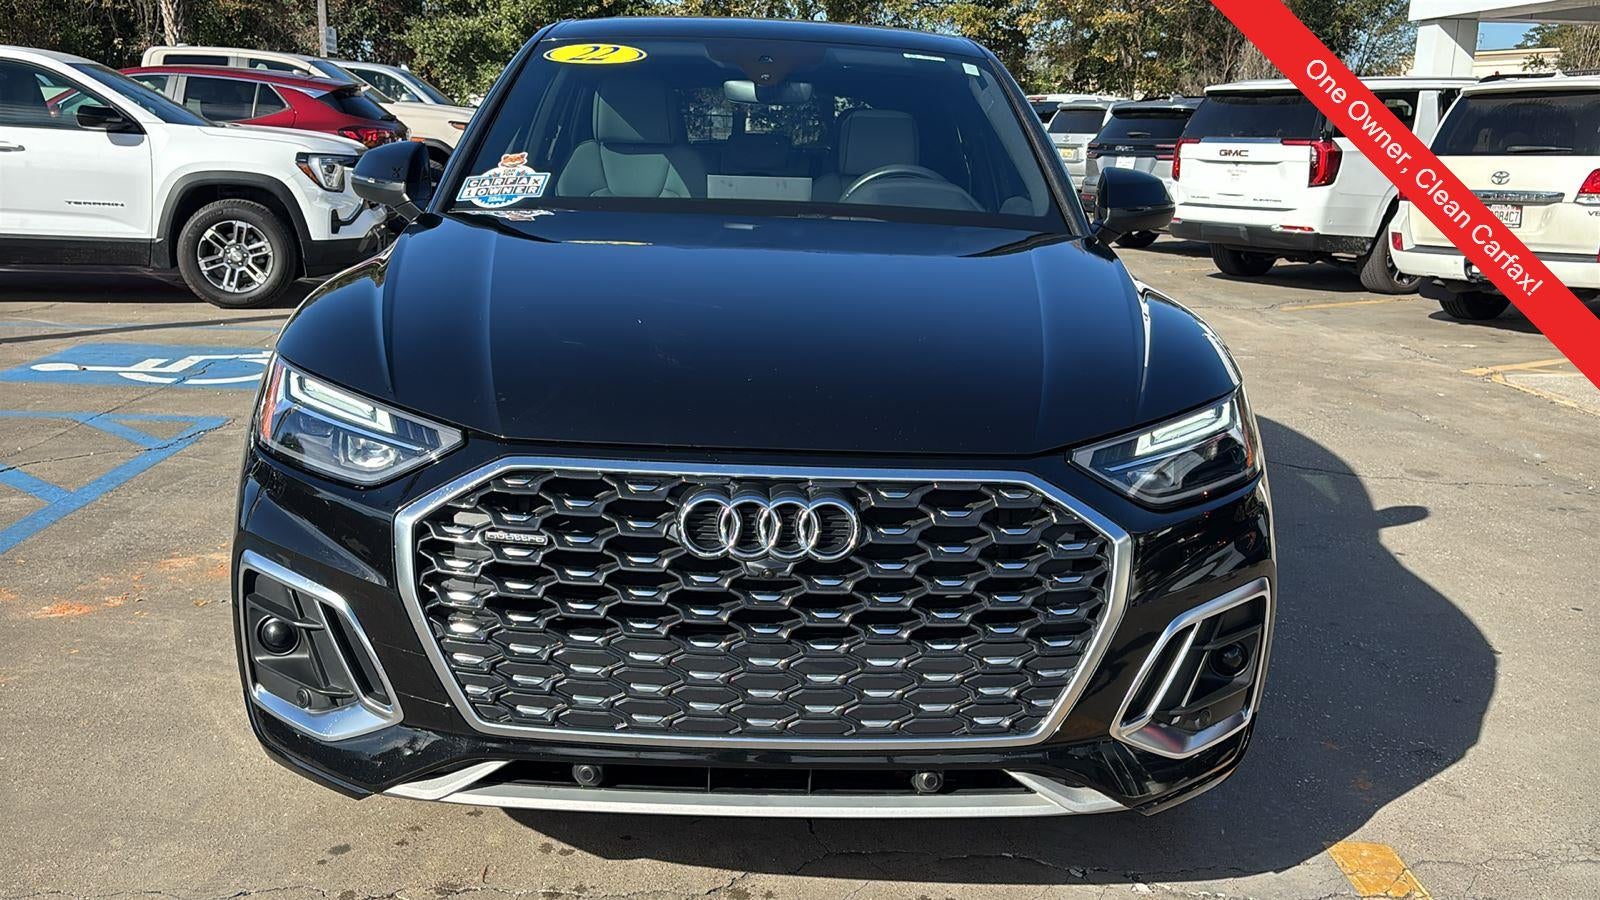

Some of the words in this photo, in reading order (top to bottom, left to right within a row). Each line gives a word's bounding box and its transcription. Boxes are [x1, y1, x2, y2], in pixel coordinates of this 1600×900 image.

[566, 45, 621, 61] 22
[1219, 149, 1249, 157] GMC
[468, 177, 541, 188] CARFAX
[487, 533, 545, 543] quattro
